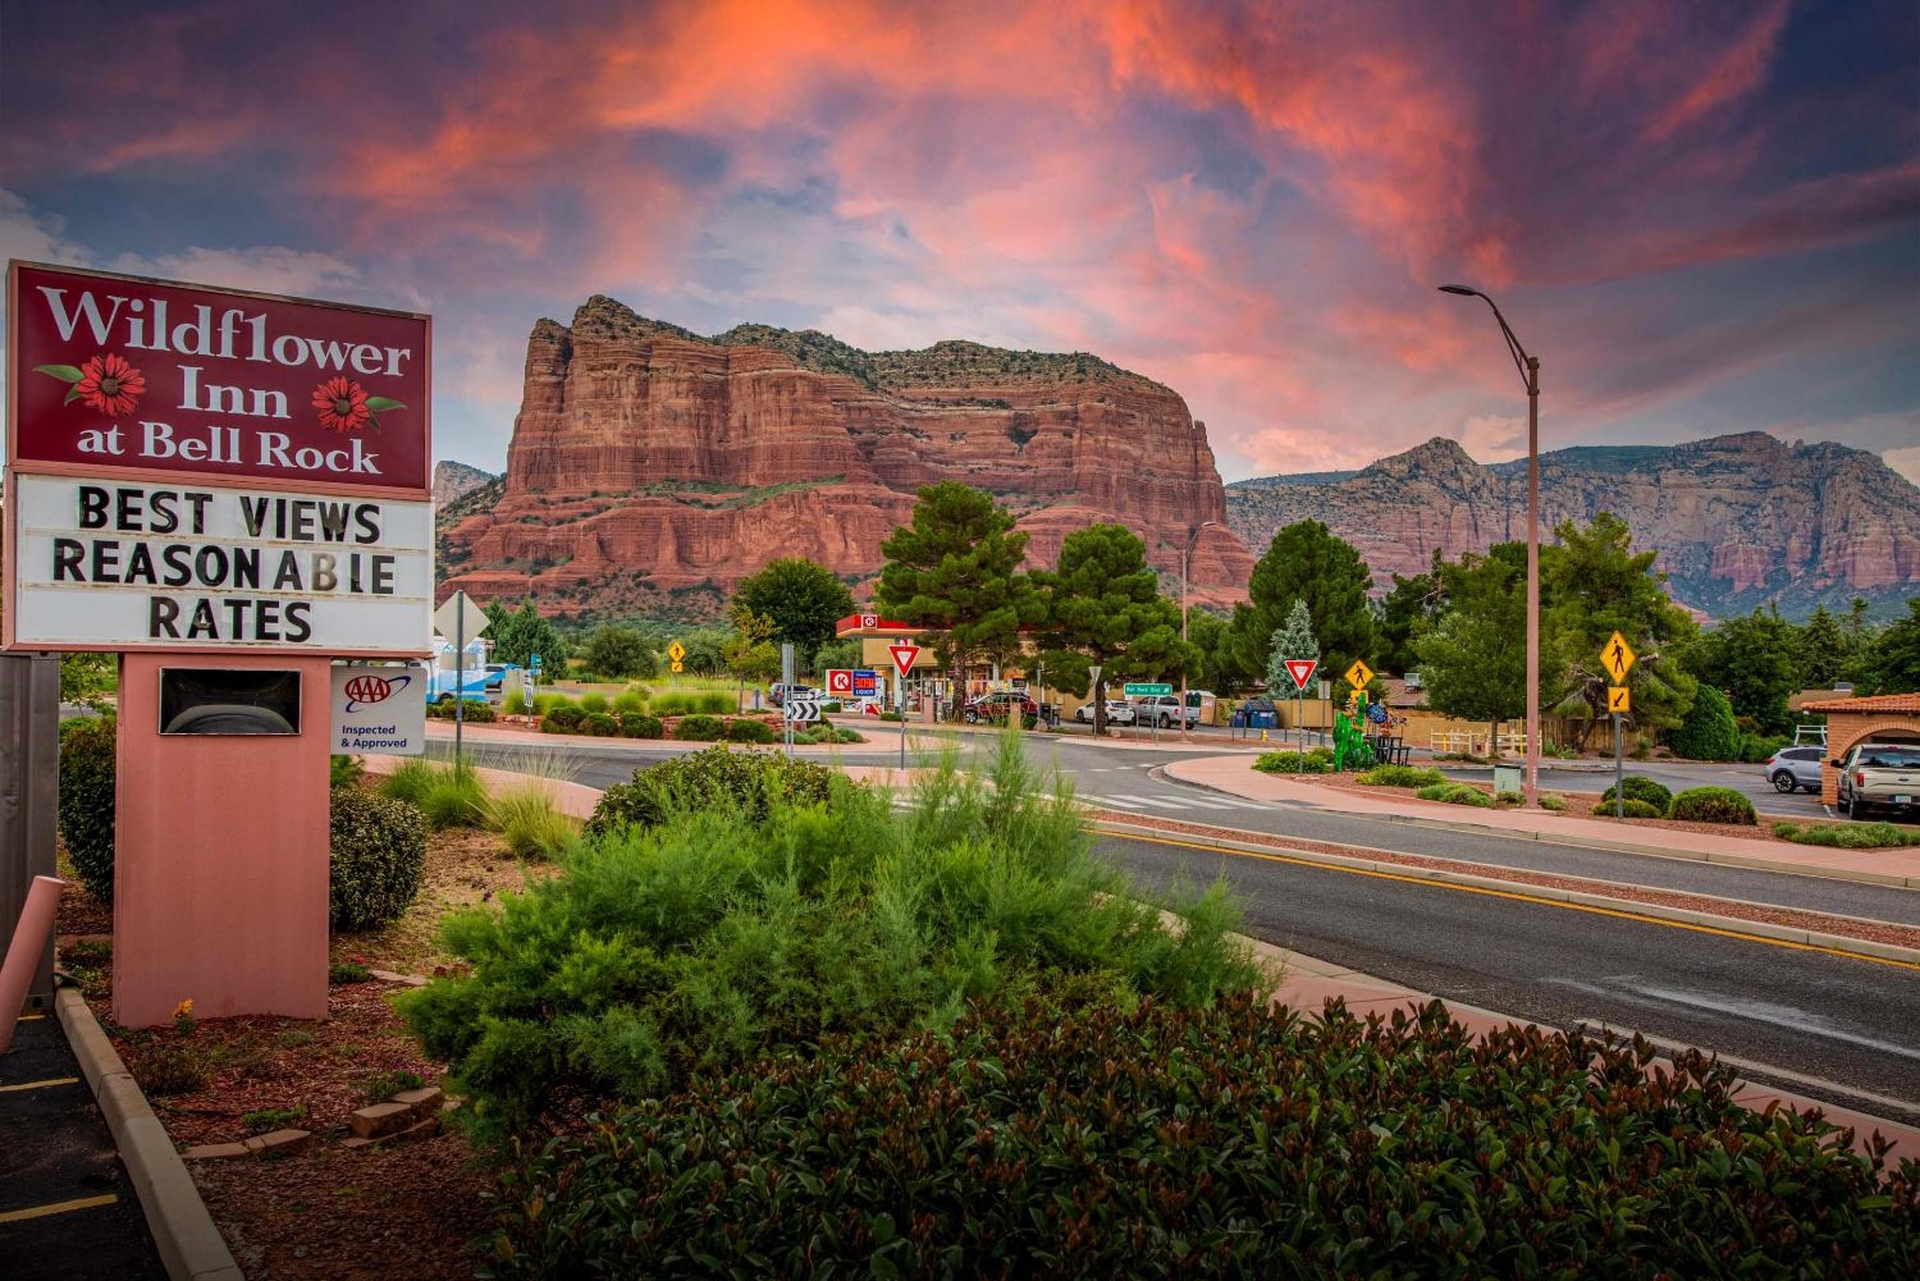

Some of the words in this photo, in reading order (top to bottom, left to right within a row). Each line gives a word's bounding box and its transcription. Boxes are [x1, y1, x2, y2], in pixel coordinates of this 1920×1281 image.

[37, 286, 411, 377] Wildflower
[177, 364, 292, 419] Inn
[77, 424, 125, 456] at
[139, 421, 242, 464] Bell
[256, 431, 383, 475] Rock
[79, 486, 213, 535] BEST
[239, 495, 380, 544] VIEWS
[53, 537, 395, 595] REASONABLE
[149, 596, 312, 643] RATES
[351, 677, 386, 702] AAA
[341, 738, 349, 748] &
[353, 738, 407, 749] Approved
[342, 725, 396, 736] Inspected
